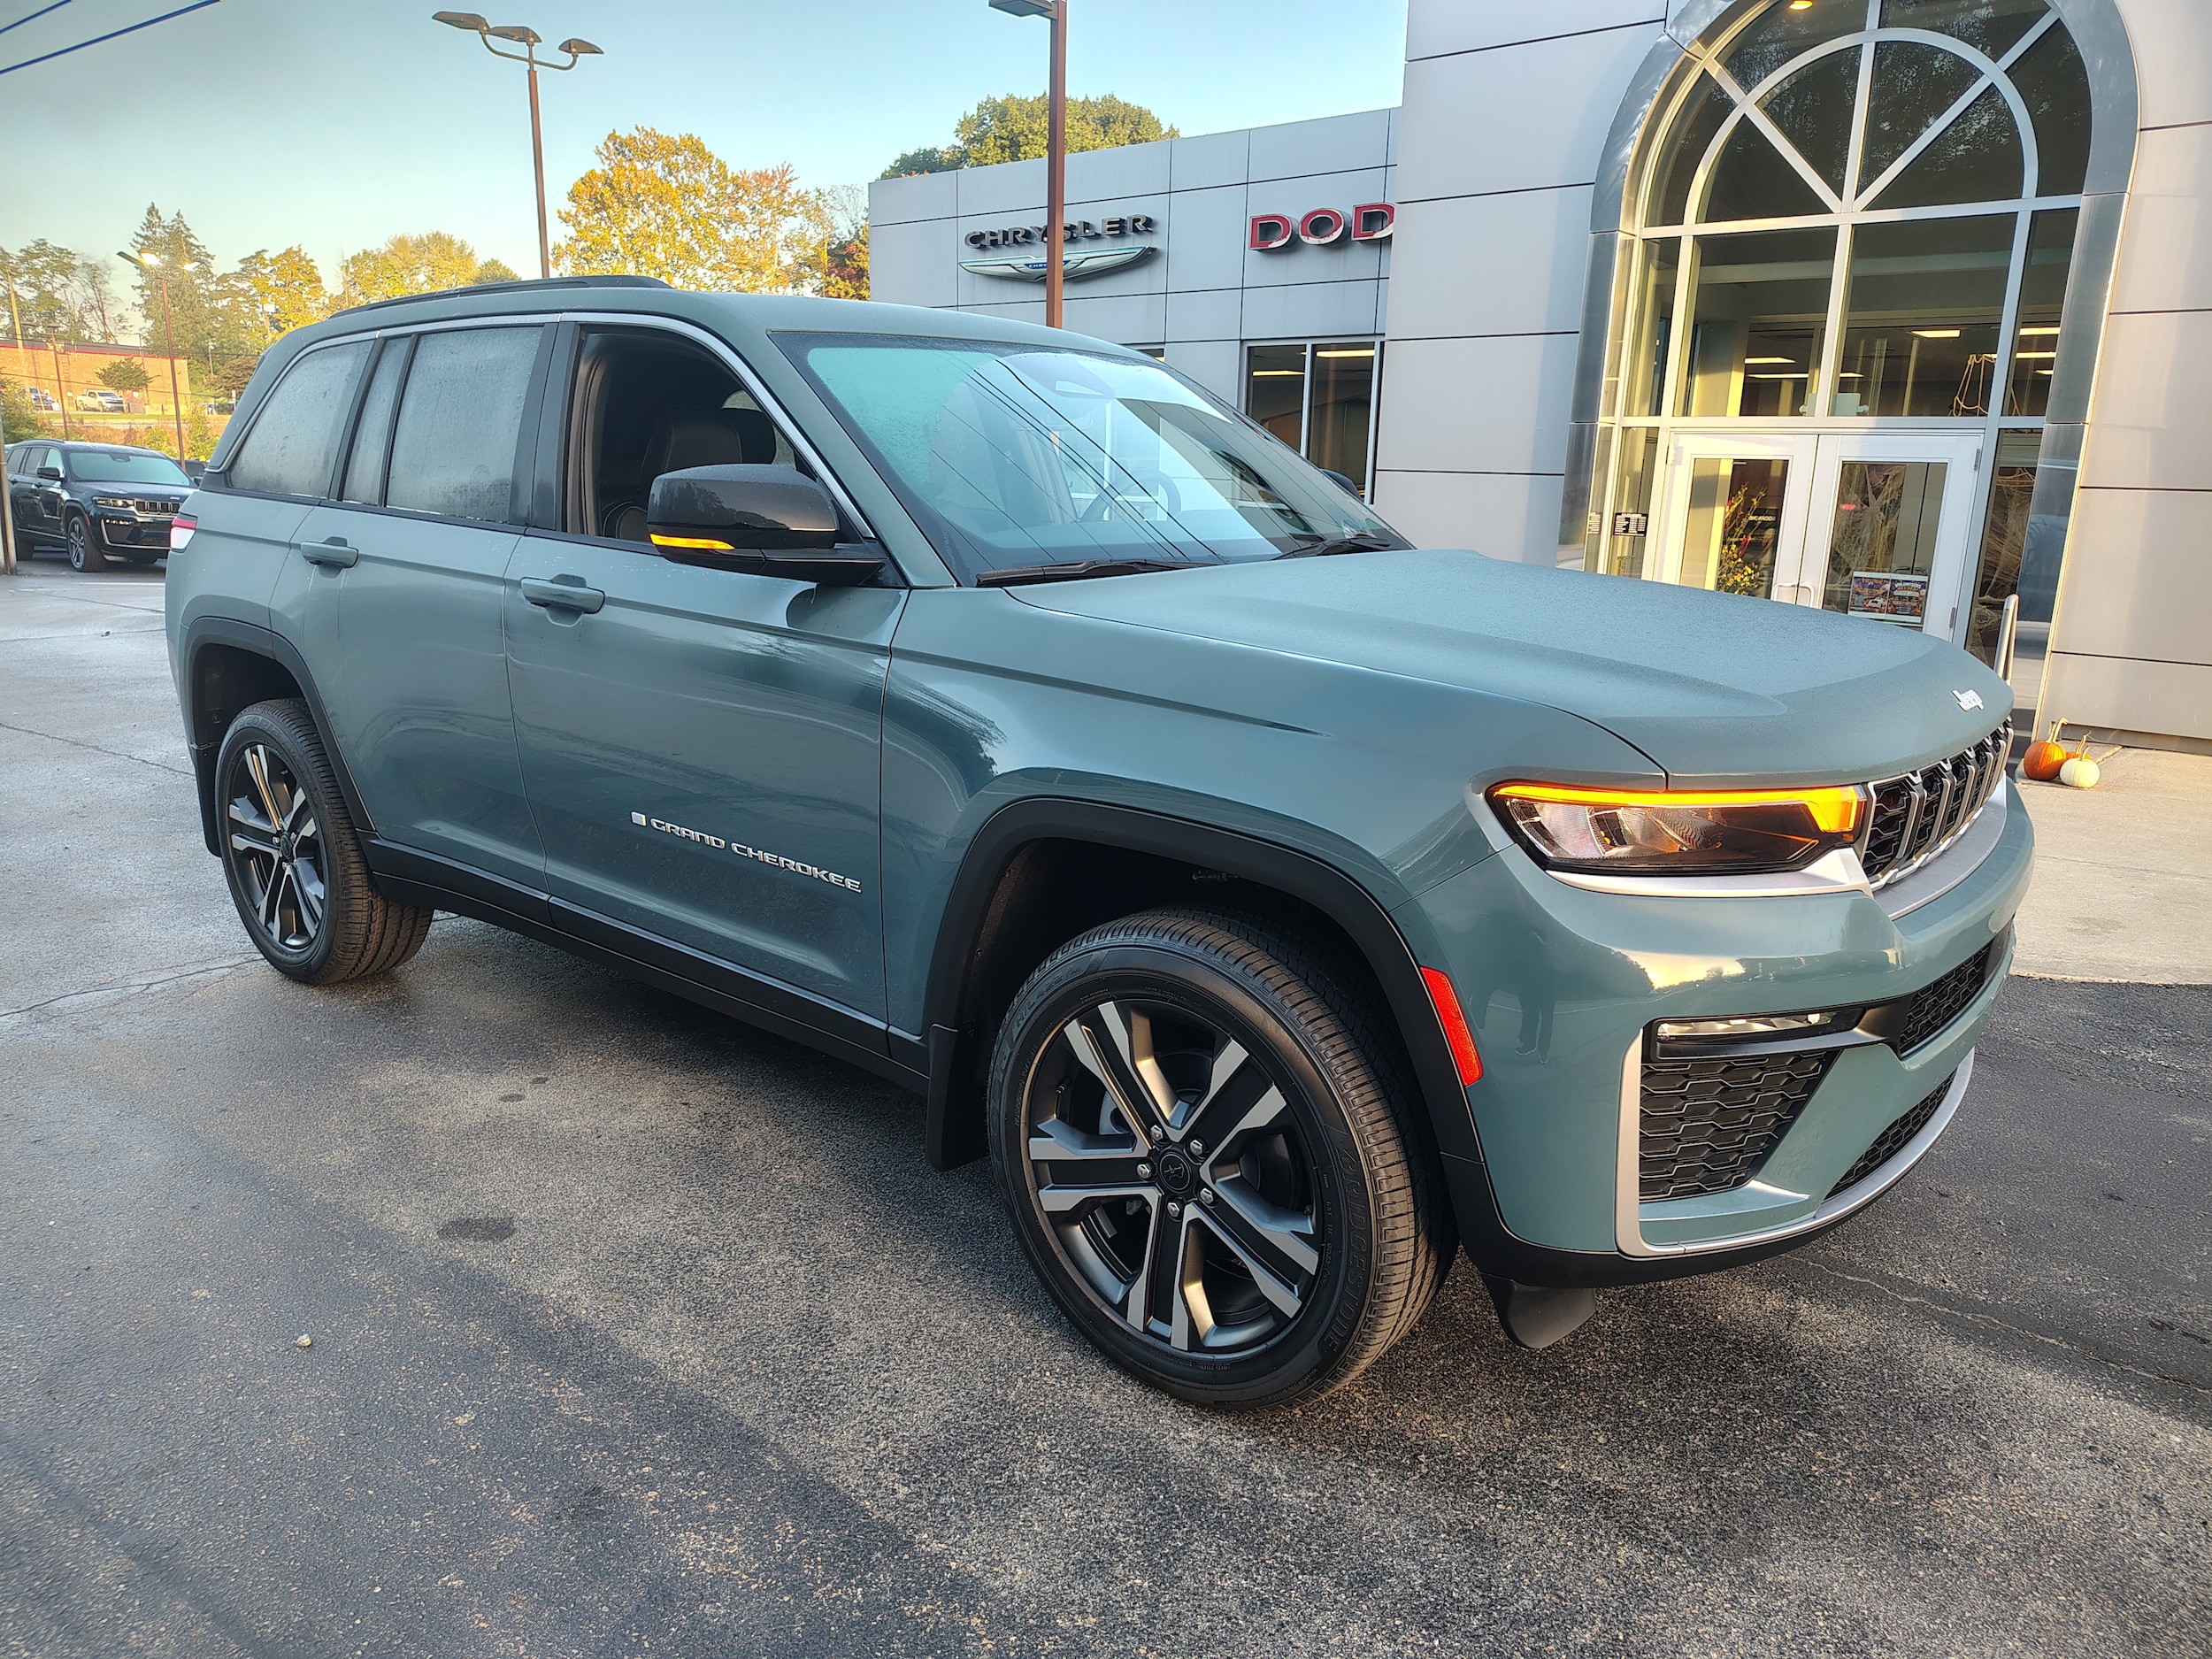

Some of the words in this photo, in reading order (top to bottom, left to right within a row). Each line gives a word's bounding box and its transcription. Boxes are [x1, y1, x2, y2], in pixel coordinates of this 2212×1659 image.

[1248, 203, 1395, 250] DOD
[1952, 689, 1985, 711] Jeep
[650, 818, 726, 849] GRAND
[731, 842, 862, 894] CHEROKEE
[1324, 1147, 1367, 1352] BRIDGESTONE
